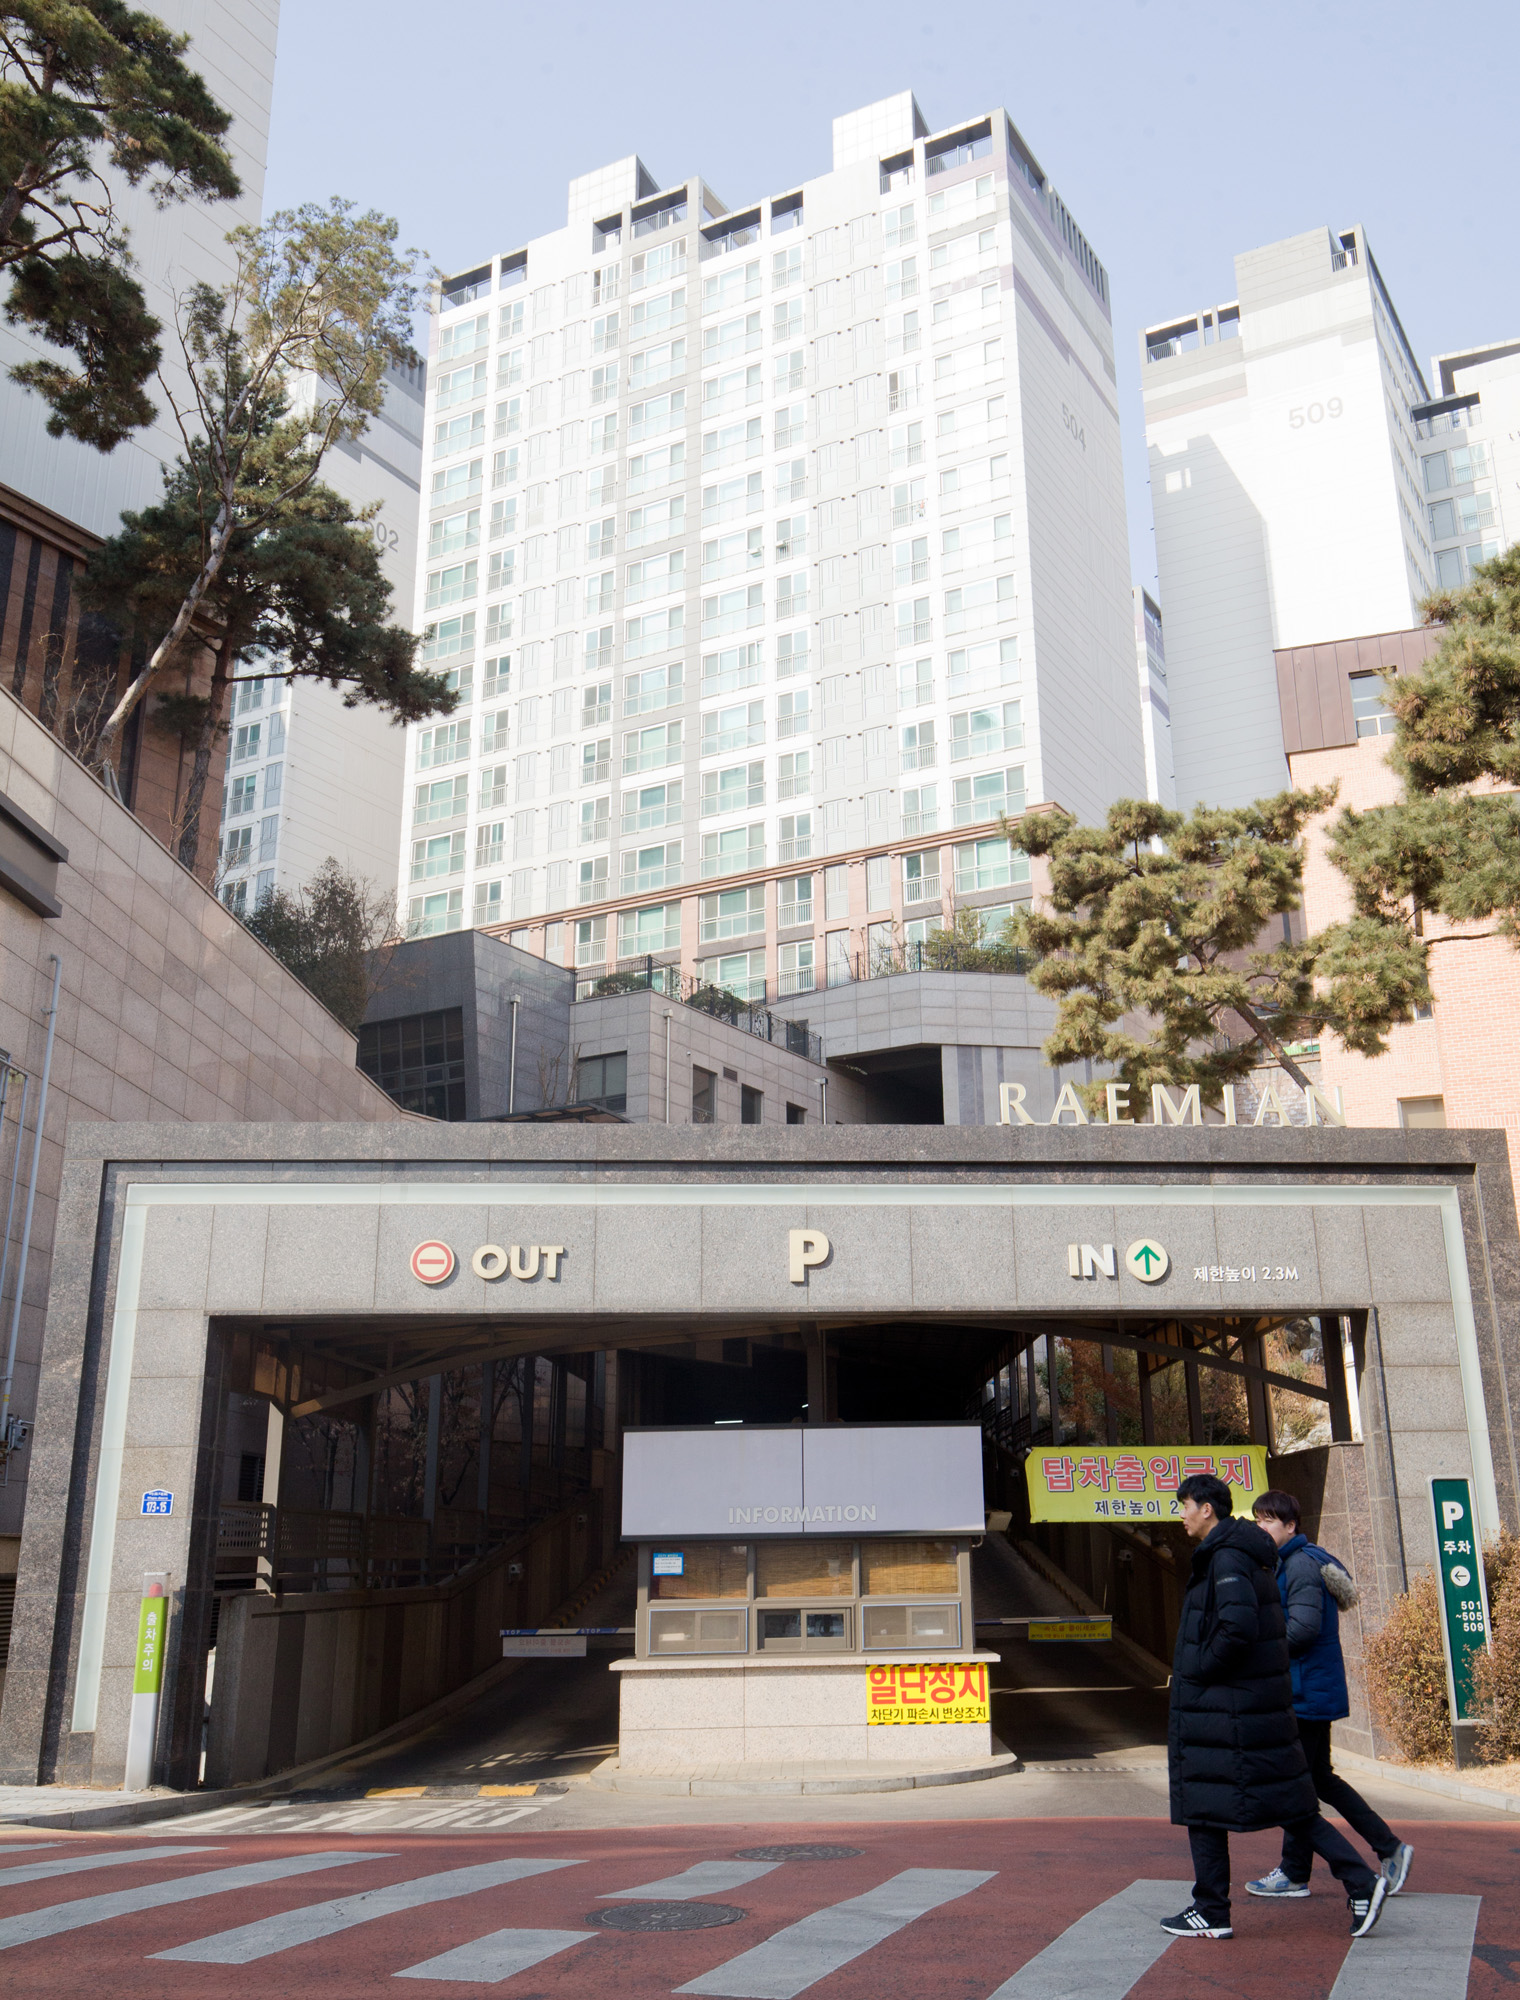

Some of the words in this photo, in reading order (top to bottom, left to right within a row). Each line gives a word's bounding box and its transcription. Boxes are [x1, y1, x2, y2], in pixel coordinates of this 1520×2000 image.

[1061, 402, 1087, 452] 504
[1288, 396, 1344, 430] 509
[999, 1082, 1347, 1127] RAEMIAN
[471, 1244, 564, 1280] OUT
[789, 1229, 830, 1283] P
[1067, 1243, 1116, 1277] IN
[1193, 1265, 1257, 1282] 제한높이
[1261, 1266, 1300, 1281] 2.3M
[728, 1504, 877, 1524] INFORMATION
[1094, 1499, 1162, 1516] 제한높이
[1169, 1500, 1181, 1515] 2
[1441, 1501, 1464, 1530] P
[1443, 1540, 1472, 1555] 주차
[1455, 1611, 1483, 1621] ~505
[1460, 1600, 1482, 1610] 501
[1463, 1622, 1484, 1632] 509
[142, 1611, 157, 1673] 출차주의
[869, 1664, 986, 1705] 일단정지
[871, 1709, 904, 1721] 차단기
[907, 1708, 940, 1720] 파손시
[942, 1706, 986, 1720] 변상조치
